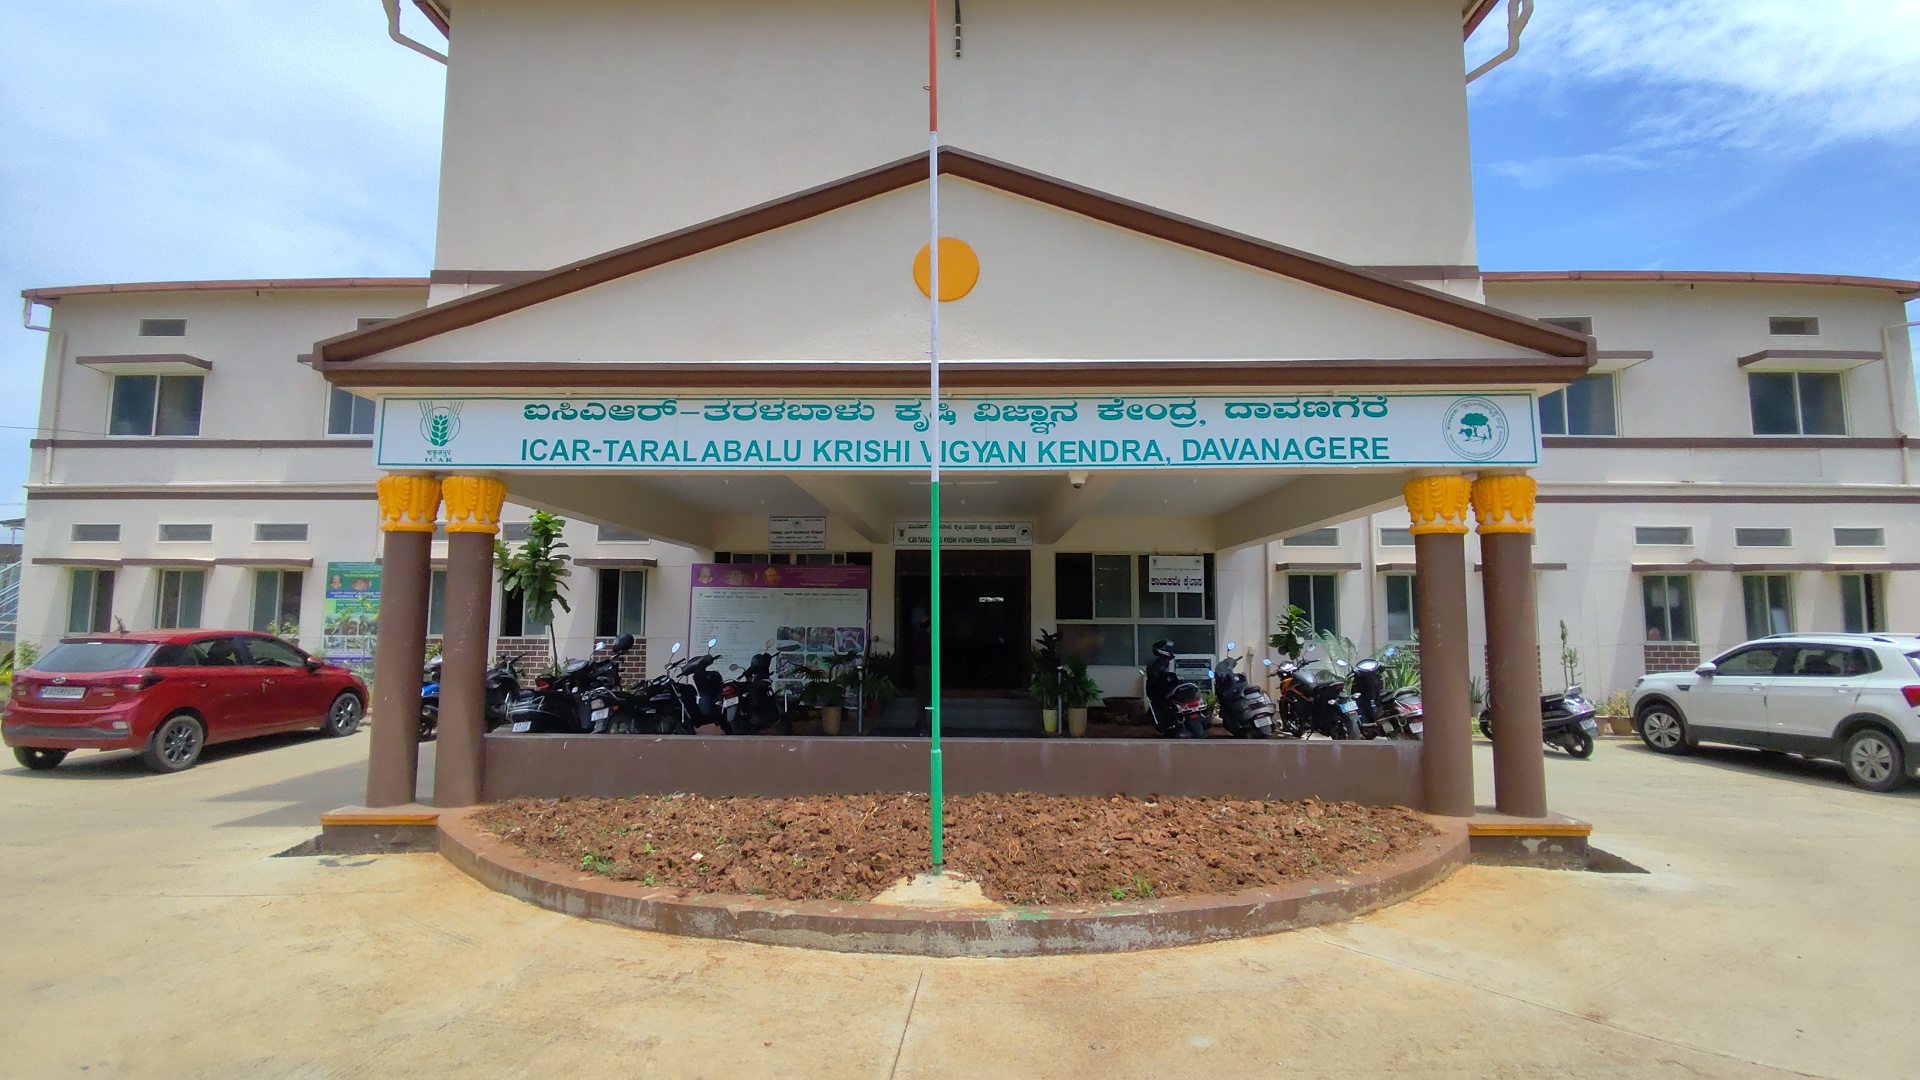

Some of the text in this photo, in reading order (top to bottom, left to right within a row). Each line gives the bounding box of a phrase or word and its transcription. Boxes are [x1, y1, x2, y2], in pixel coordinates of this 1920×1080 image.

[973, 399, 1079, 434] ವಿಜ್ಞಾನ
[1097, 397, 1207, 428] ಕೇಂದ್ರ,
[1224, 395, 1390, 419] ದಾವಣಗೆರೆ
[521, 439, 802, 462] ICAR-TARALABALU
[812, 440, 911, 462] KRISHI
[1037, 439, 1172, 466] KENDRA,
[1182, 438, 1391, 464] DAVANAGERE
